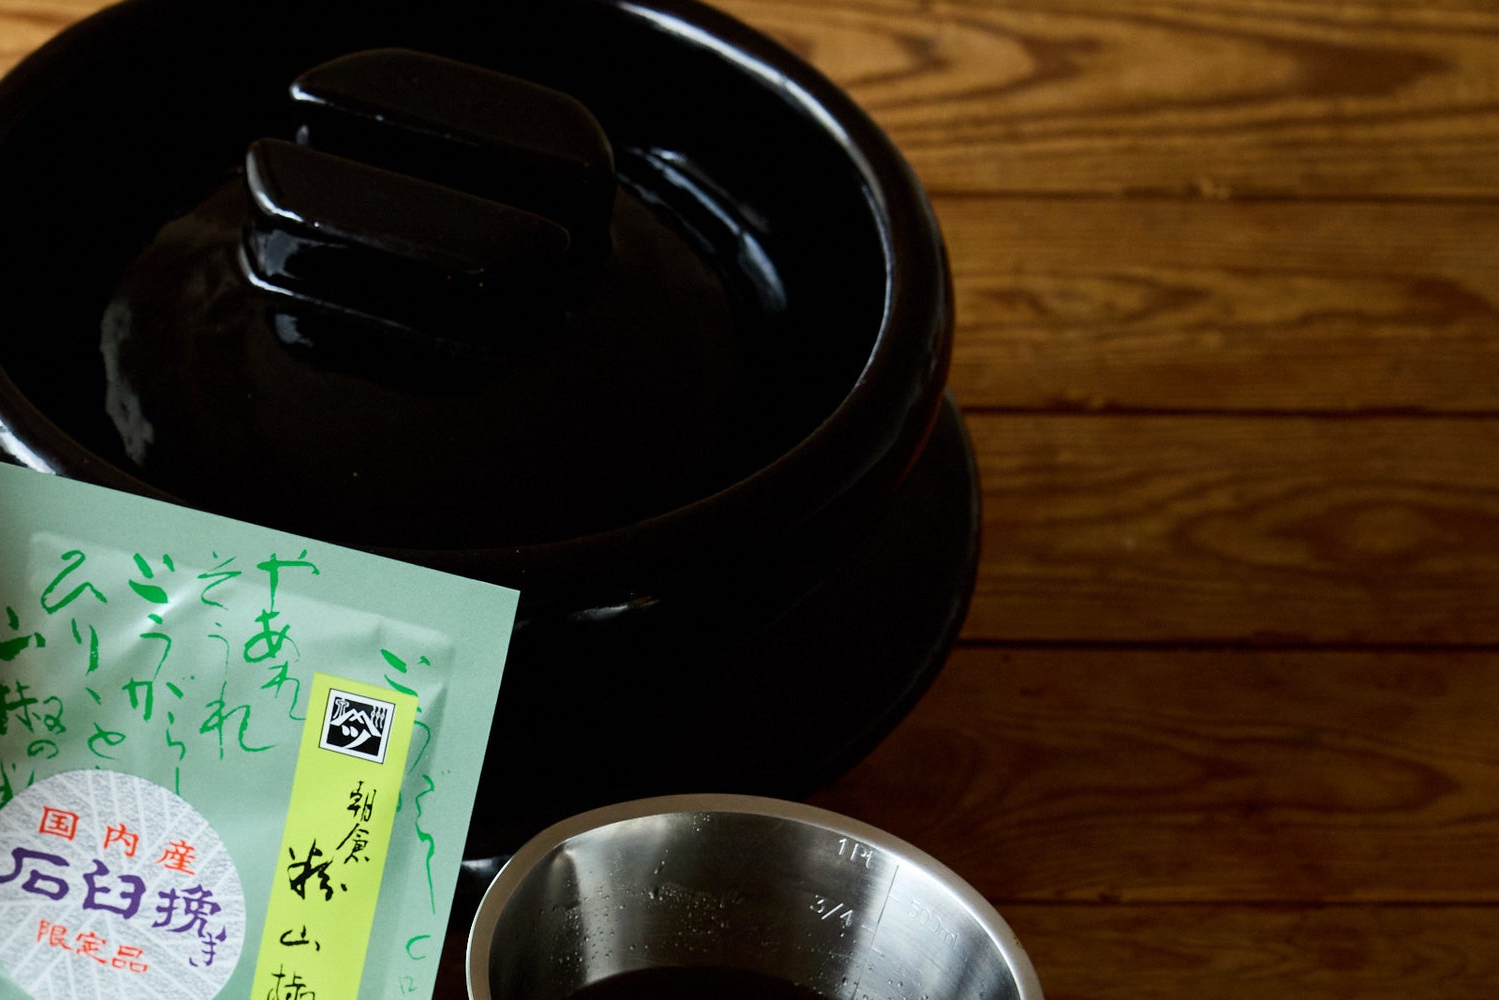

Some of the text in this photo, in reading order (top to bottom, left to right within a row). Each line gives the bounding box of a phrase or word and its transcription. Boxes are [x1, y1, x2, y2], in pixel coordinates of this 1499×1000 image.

[38, 806, 196, 876] 国内産
[37, 919, 148, 973] 限定品
